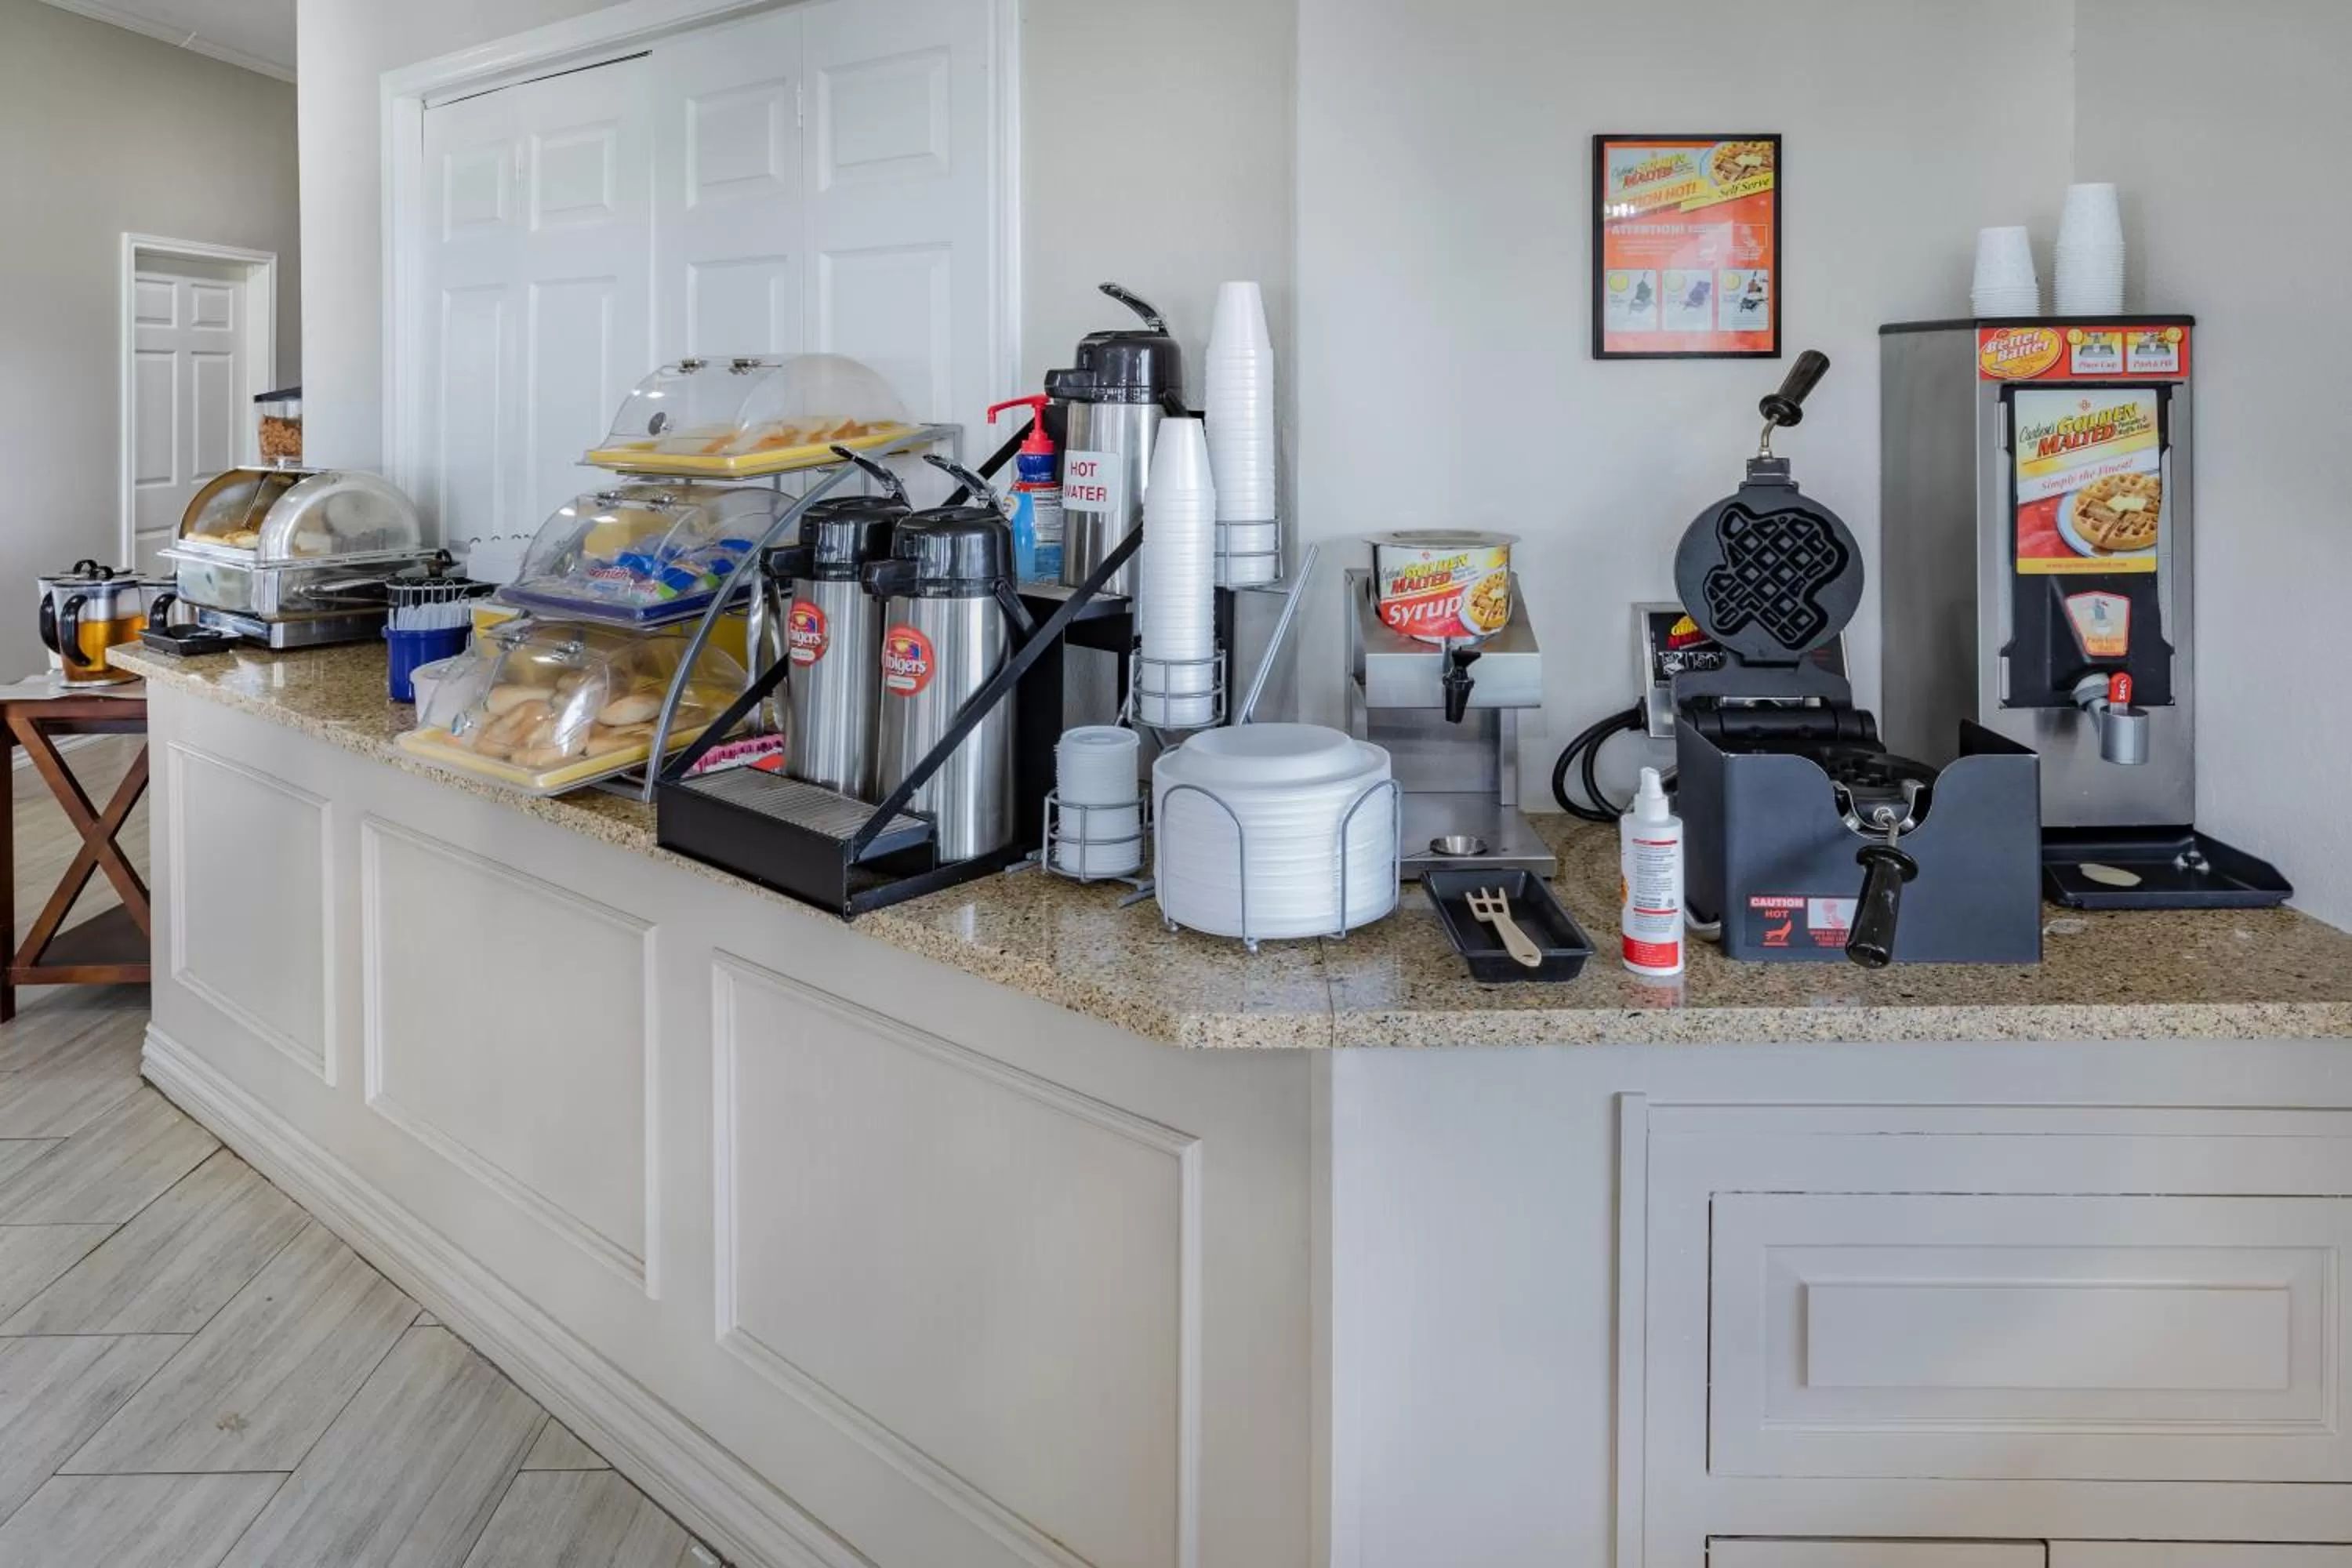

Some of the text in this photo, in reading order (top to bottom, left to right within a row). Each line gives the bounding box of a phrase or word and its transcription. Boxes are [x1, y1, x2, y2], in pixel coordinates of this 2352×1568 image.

[1667, 182, 1697, 200] HOT!
[1719, 178, 1769, 198] Self Serve
[1985, 330, 2039, 354] Better
[1998, 339, 2049, 362] Batter
[2057, 401, 2137, 436] GOLDEN
[2037, 423, 2116, 457] MALTED
[1070, 461, 1098, 477] HOT
[2042, 474, 2074, 489] Simply
[2079, 469, 2096, 481] the
[1065, 484, 1107, 502] WATER
[1388, 595, 1463, 626] Syrup
[1750, 896, 1805, 908] CAUTION
[1765, 909, 1789, 919] HOT
